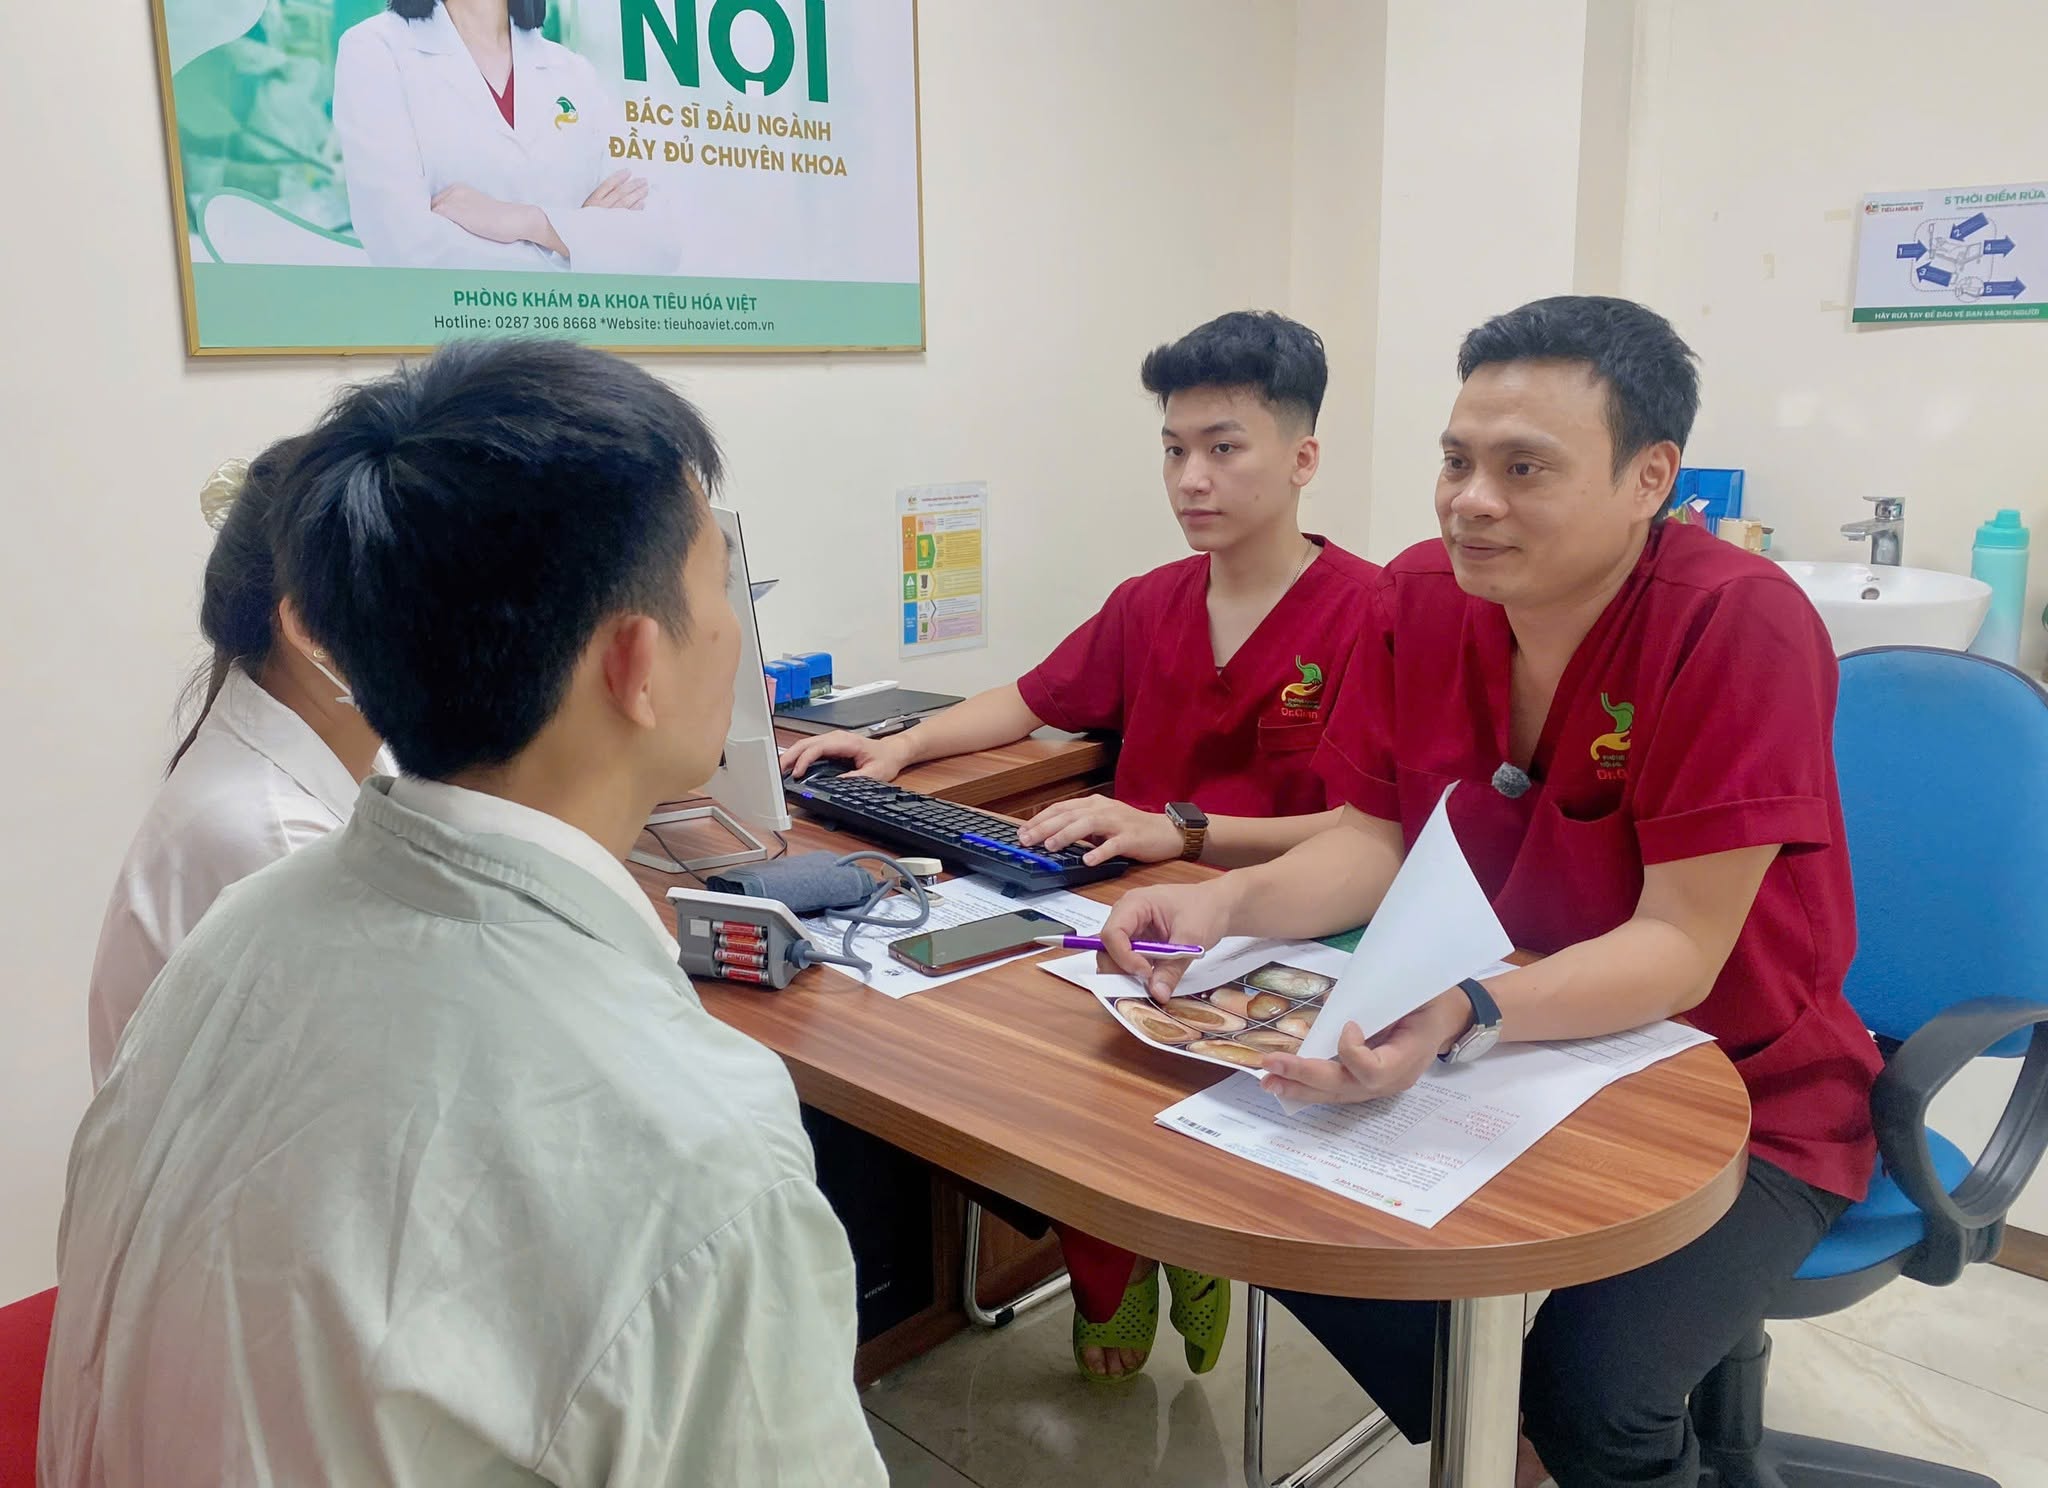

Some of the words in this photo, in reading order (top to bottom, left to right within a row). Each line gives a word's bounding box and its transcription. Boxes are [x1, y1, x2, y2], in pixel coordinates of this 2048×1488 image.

[625, 96, 674, 126] BÁC
[680, 102, 700, 129] SĨ
[706, 100, 751, 134] ĐẦU
[757, 112, 831, 142] NGÀNH
[608, 127, 656, 161] ĐẦY
[663, 135, 694, 164] ĐỦ
[701, 144, 785, 172] CHUYÊN
[791, 153, 848, 177] KHOA
[1944, 196, 1952, 205] 5
[1953, 229, 1962, 238] 2
[1984, 243, 1992, 252] 4
[1919, 268, 1927, 276] 3
[1985, 285, 1993, 294] 5
[454, 288, 518, 308] PHÒNG
[522, 289, 573, 308] KHÁM
[577, 293, 601, 309] ĐA
[605, 294, 650, 309] KHOA
[653, 292, 687, 310] TIÊU
[691, 293, 723, 311] HÓA
[726, 293, 757, 314] VIỆT
[434, 315, 491, 329] Hotline:
[495, 315, 529, 329] 0287
[533, 316, 559, 329] 306
[563, 316, 597, 329] 8668
[664, 317, 775, 331] tieuhoaviet.com.vn
